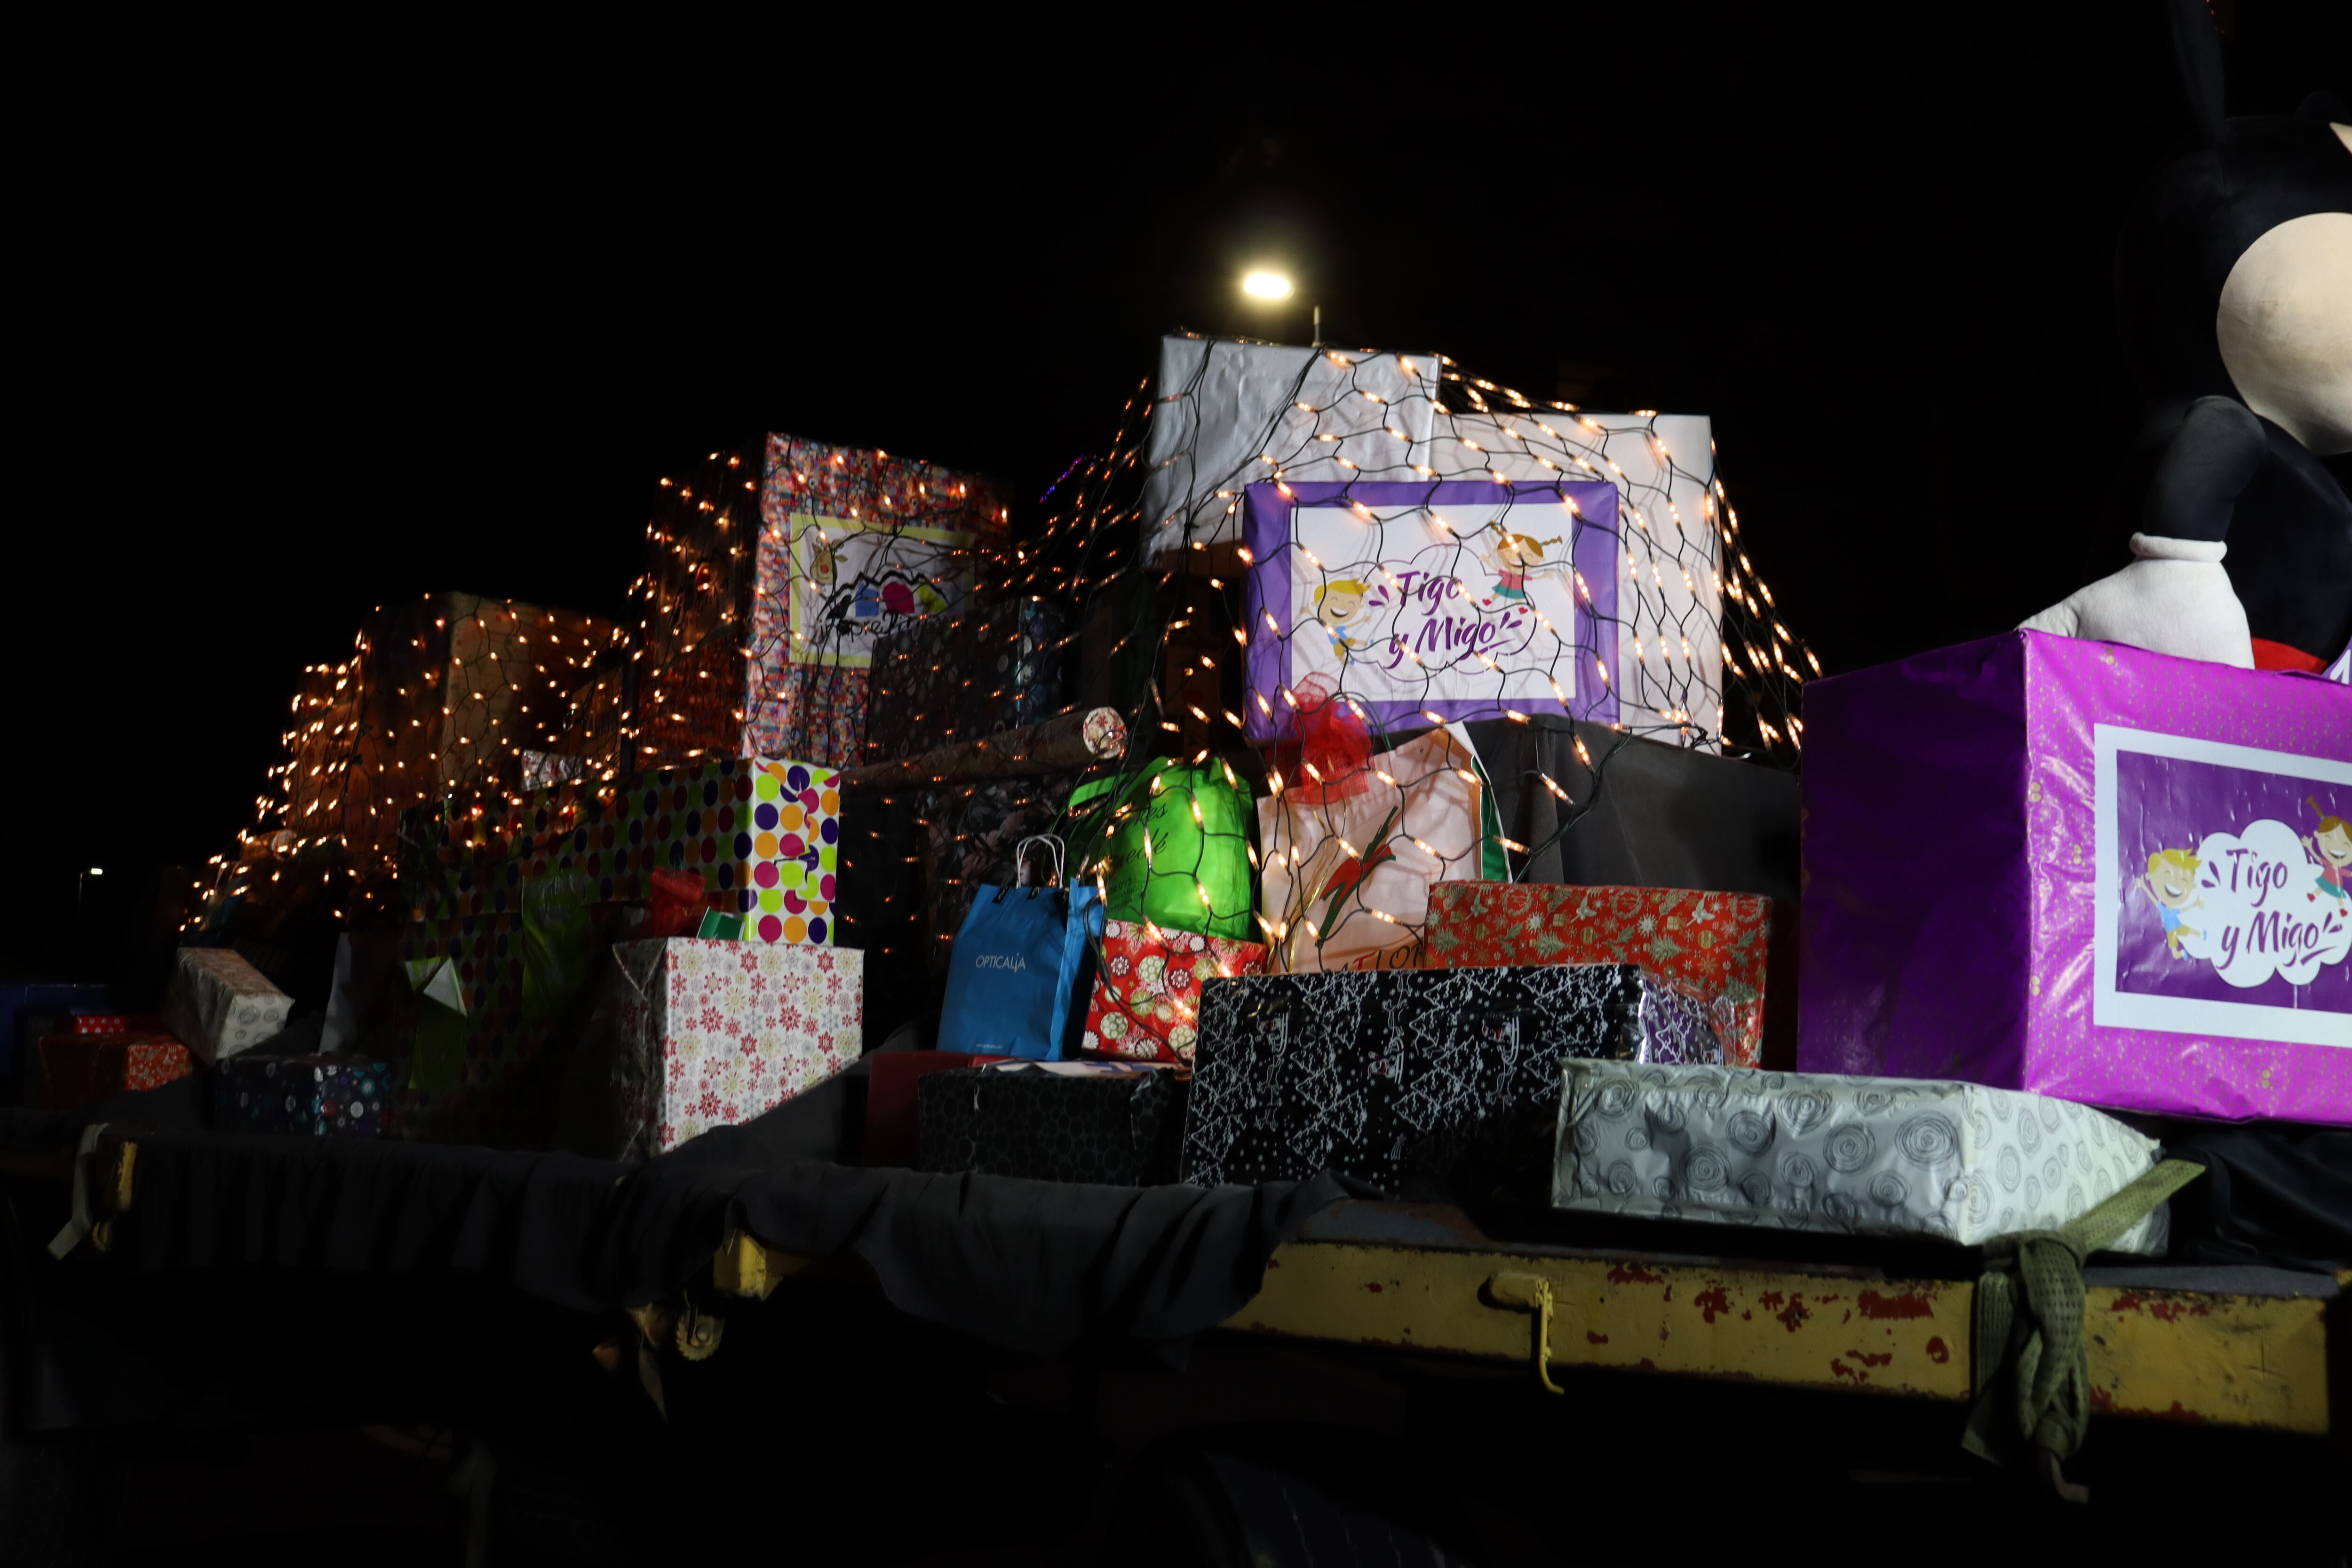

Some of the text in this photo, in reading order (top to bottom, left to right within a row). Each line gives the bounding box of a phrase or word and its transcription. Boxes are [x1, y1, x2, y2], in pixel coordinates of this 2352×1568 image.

[1396, 571, 1462, 616] Tigo
[1383, 617, 1496, 669] y Migo
[2226, 848, 2288, 907] Tigo
[2216, 911, 2319, 970] y Migo
